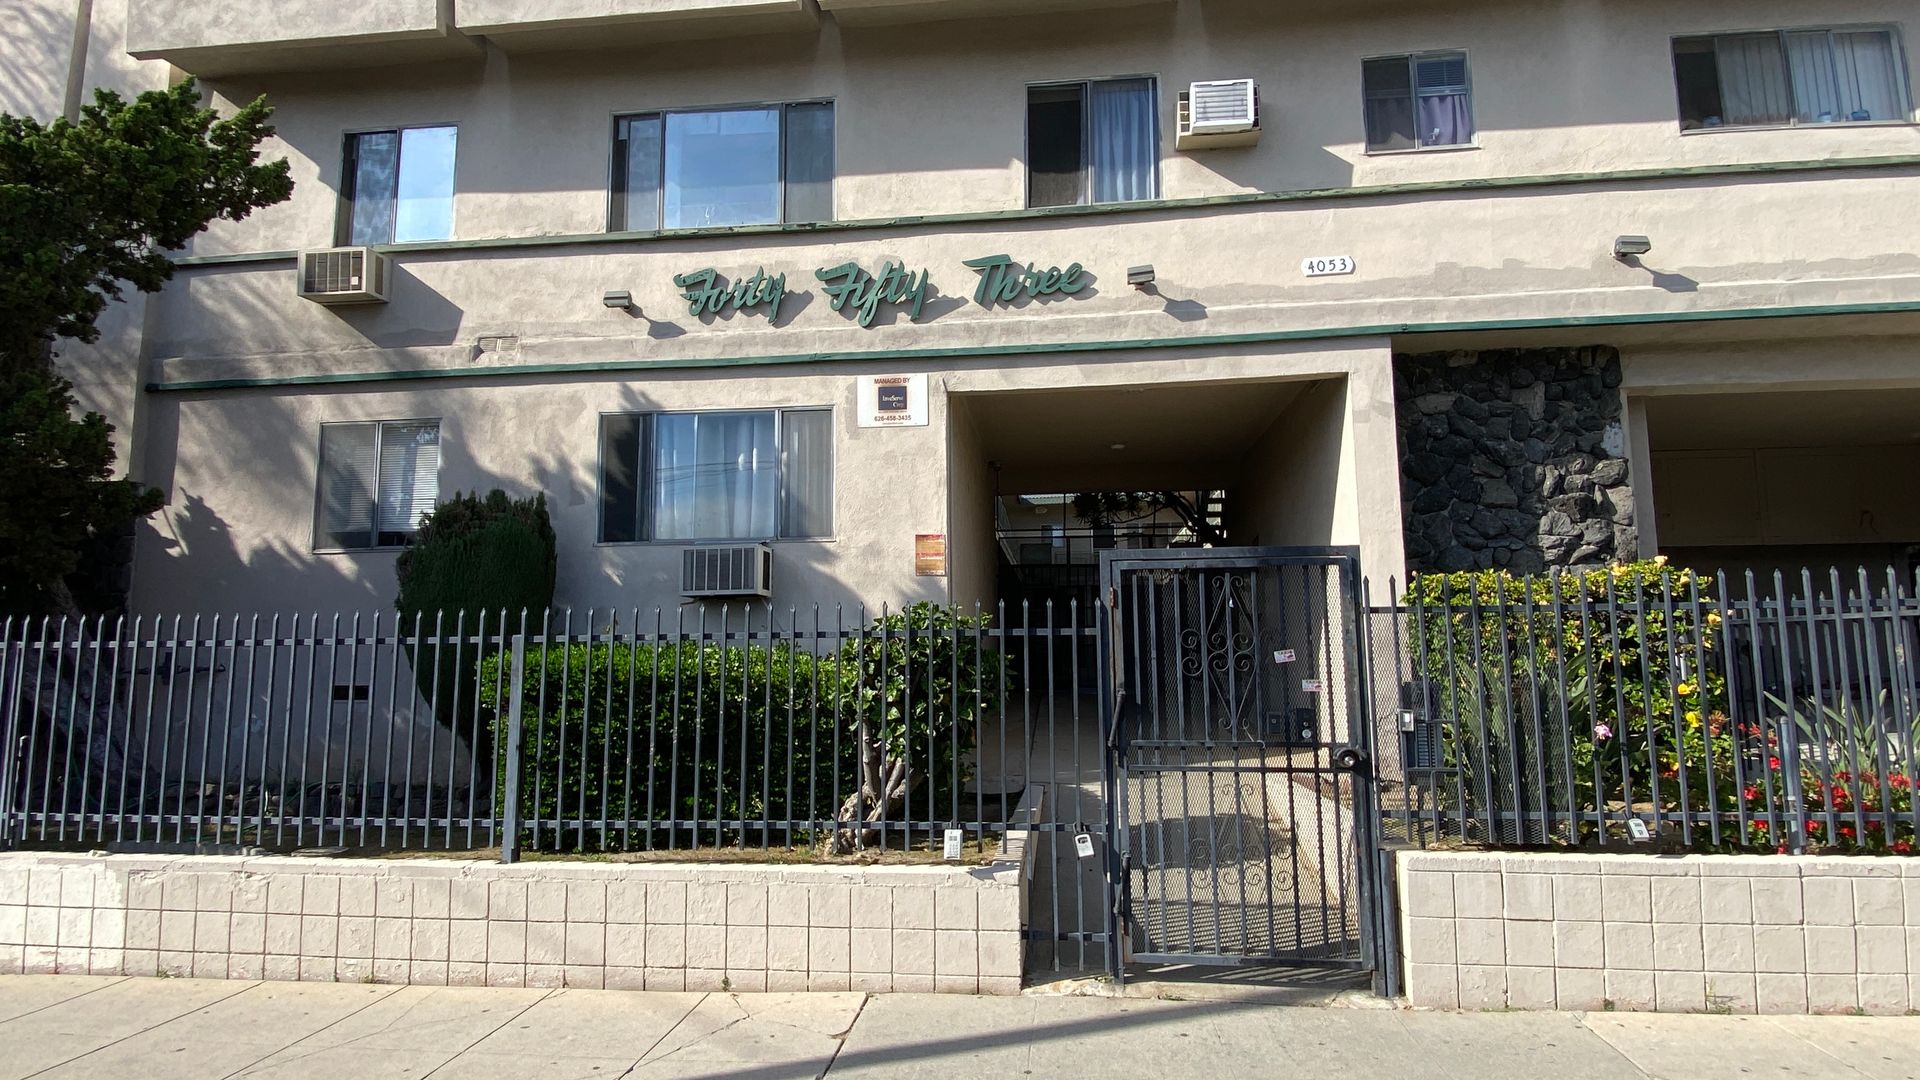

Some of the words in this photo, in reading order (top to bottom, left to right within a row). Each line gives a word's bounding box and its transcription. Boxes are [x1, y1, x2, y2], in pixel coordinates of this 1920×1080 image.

[1308, 258, 1347, 273] 4053
[673, 265, 786, 325] Forty
[815, 260, 928, 328] Fifty
[961, 254, 1088, 305] Three
